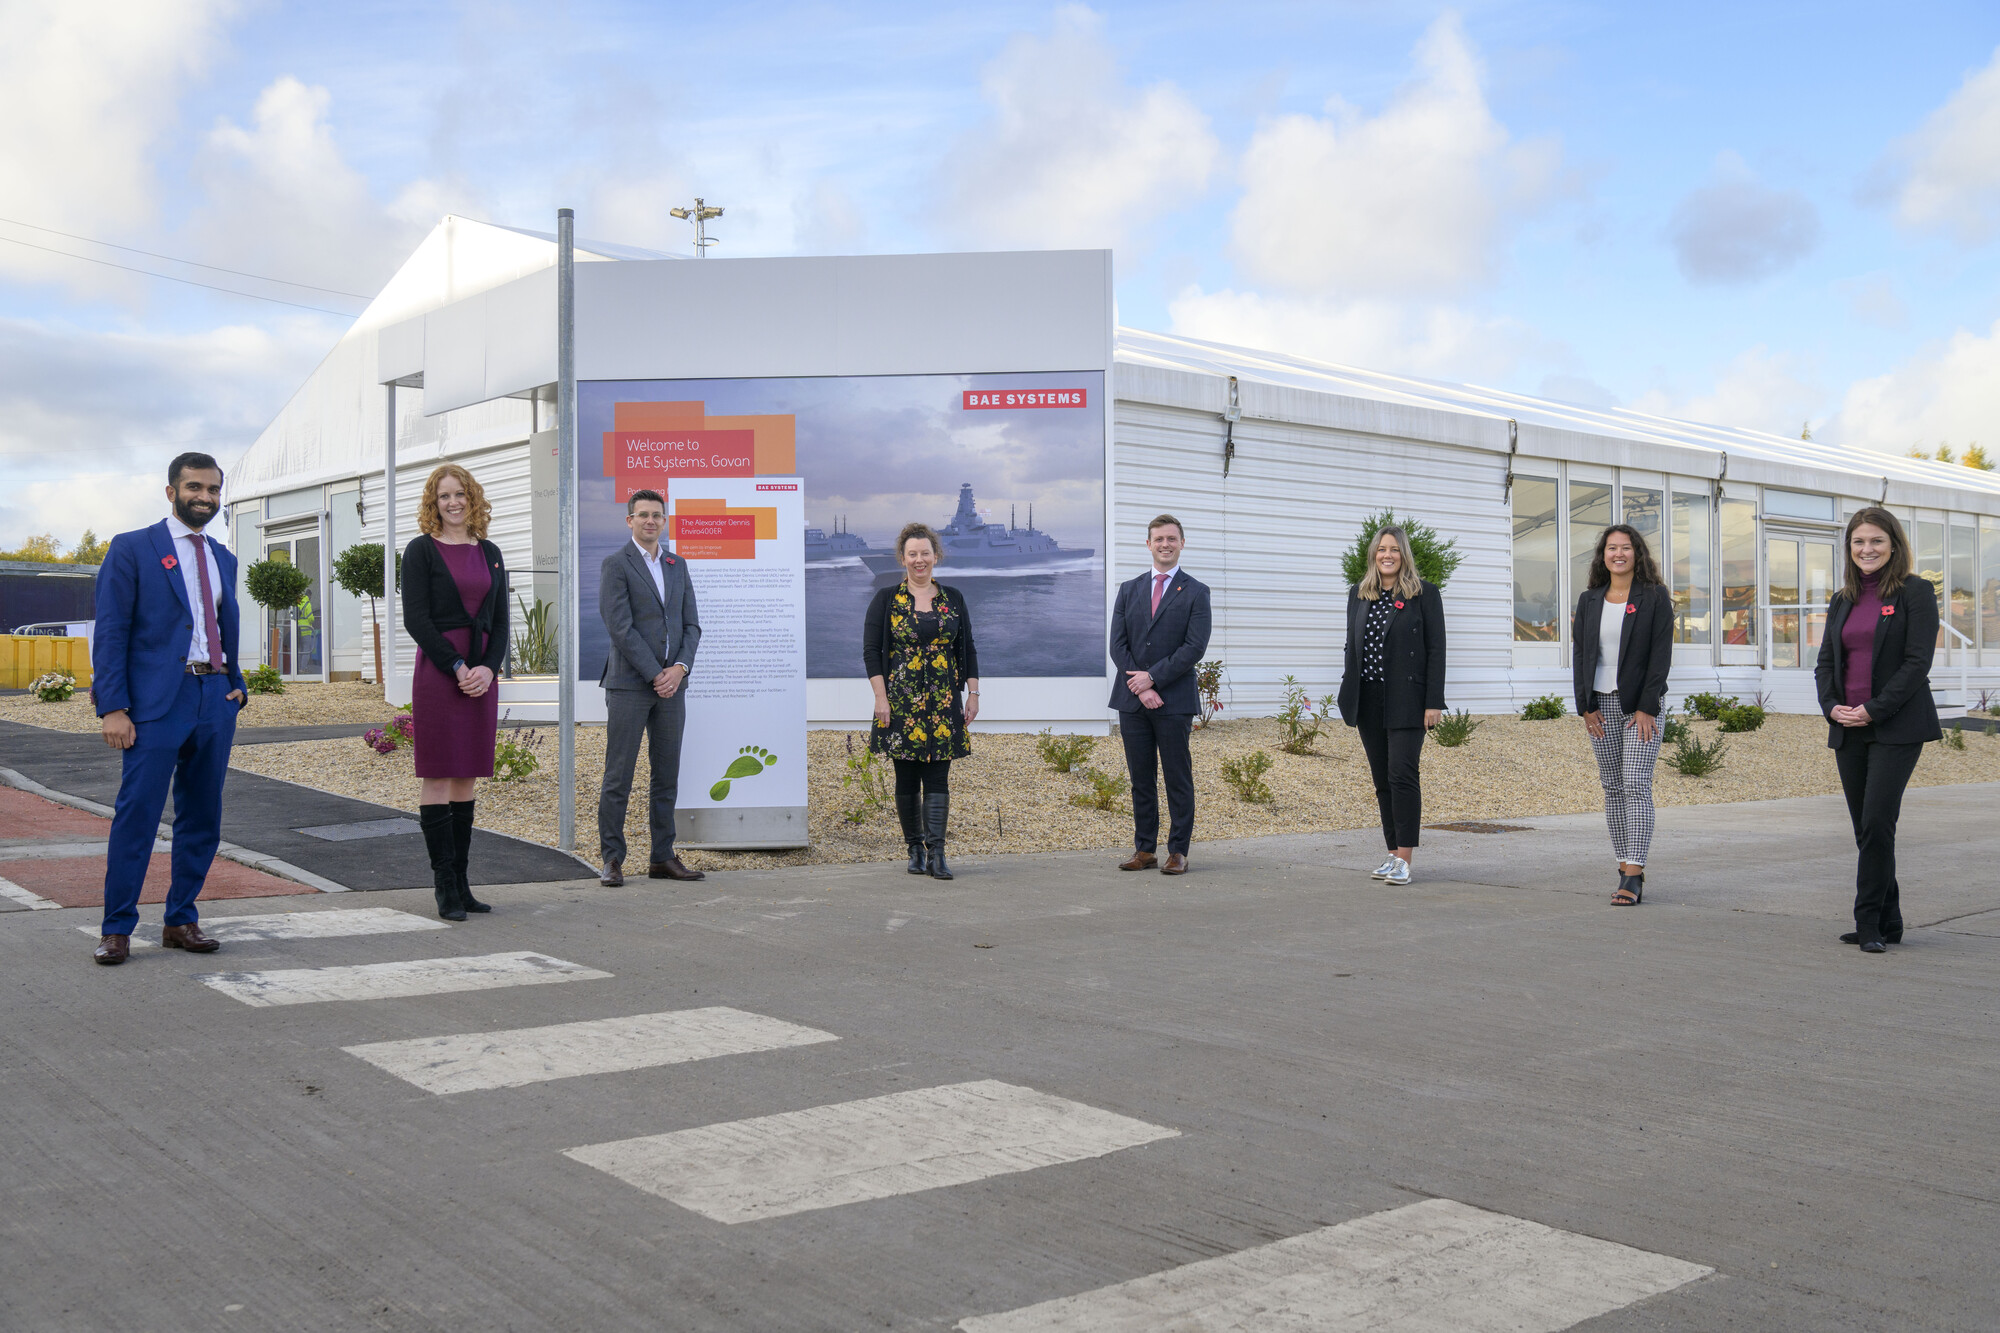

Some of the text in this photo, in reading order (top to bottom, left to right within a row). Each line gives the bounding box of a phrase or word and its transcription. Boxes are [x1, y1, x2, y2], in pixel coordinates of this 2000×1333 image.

[969, 393, 1081, 405] BAE SYSTEMS
[626, 438, 700, 451] Welcome to
[627, 454, 750, 472] BAE Systems, Govan
[534, 490, 542, 498] The
[681, 527, 722, 535] Enviro400ER
